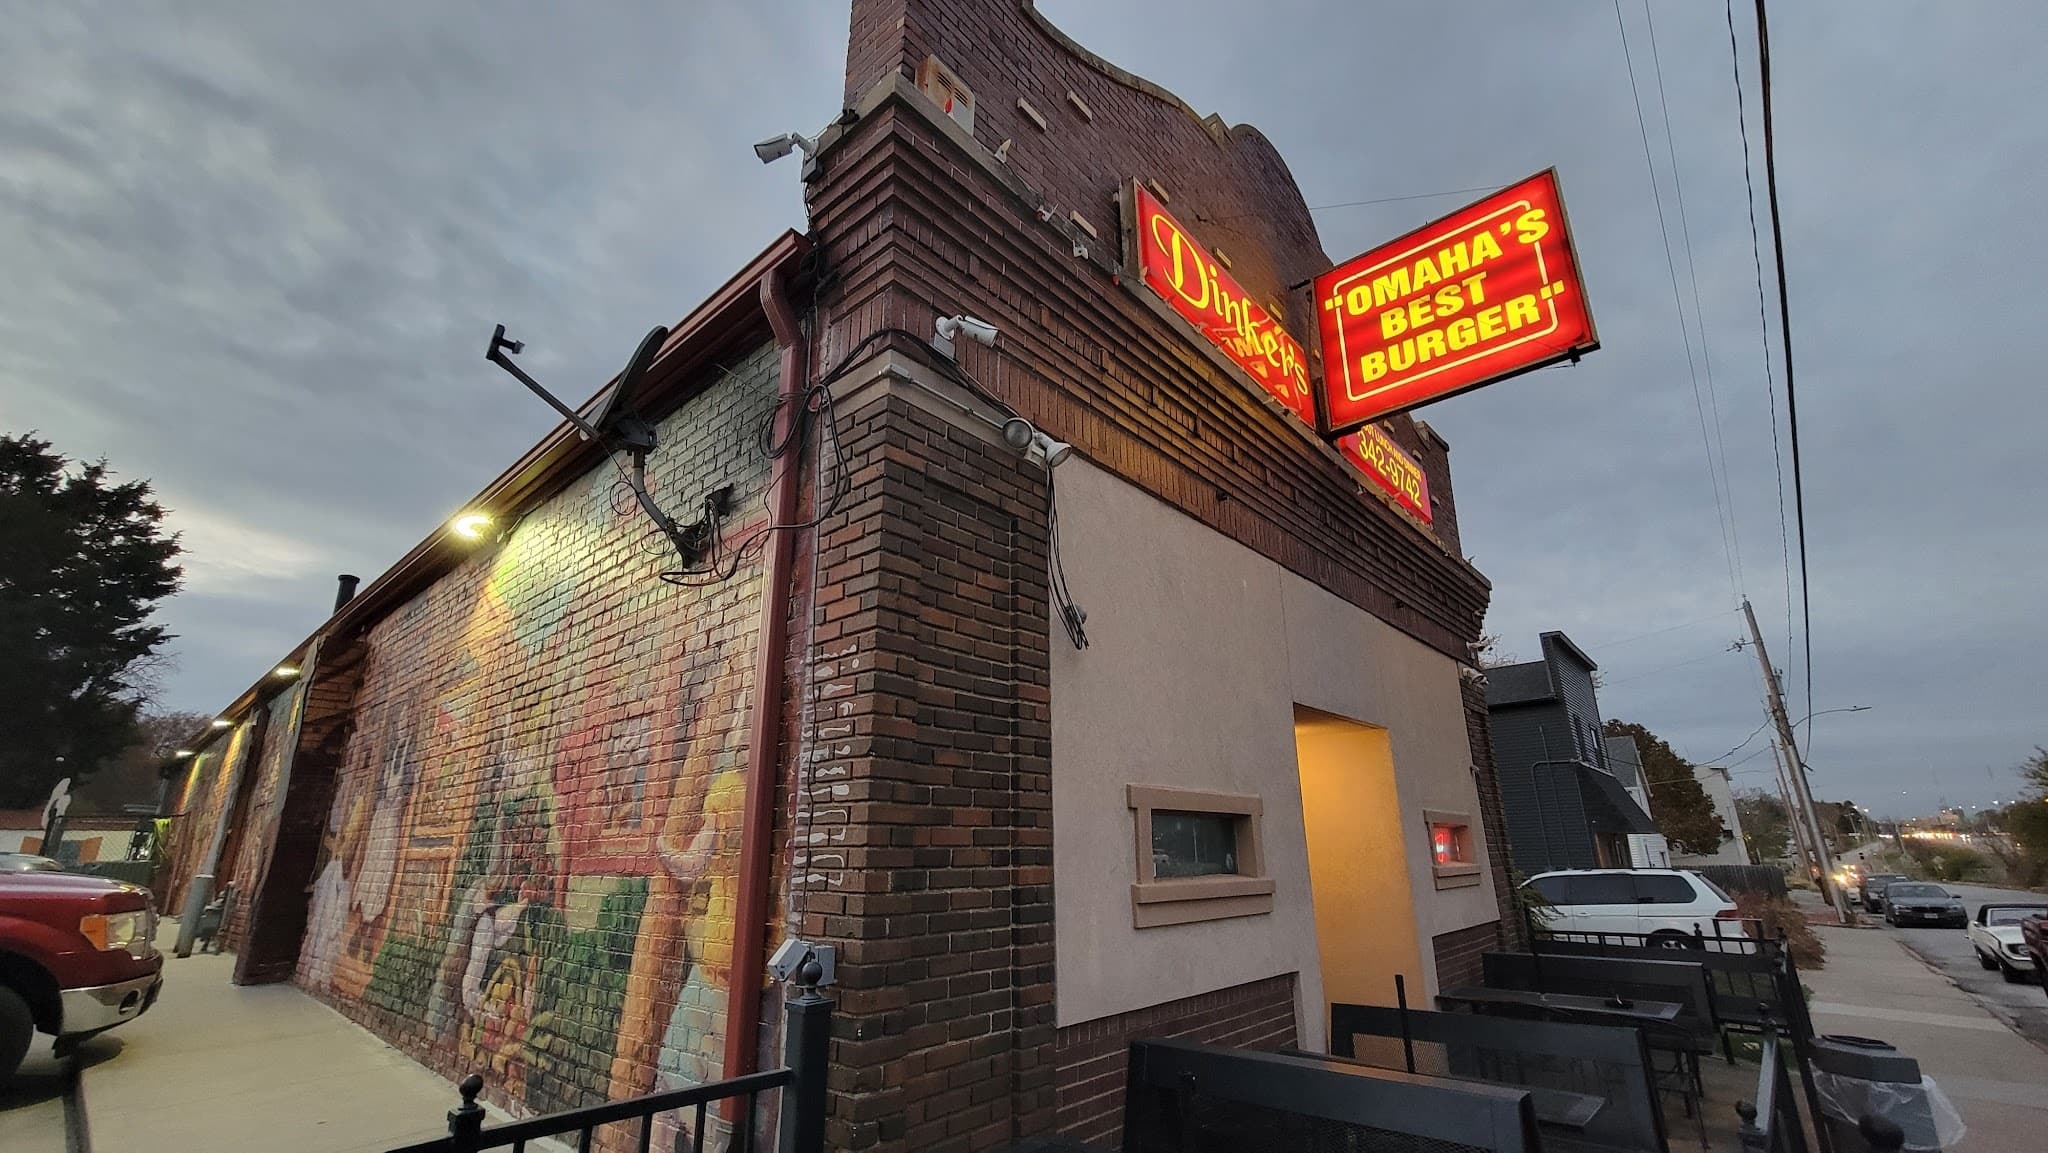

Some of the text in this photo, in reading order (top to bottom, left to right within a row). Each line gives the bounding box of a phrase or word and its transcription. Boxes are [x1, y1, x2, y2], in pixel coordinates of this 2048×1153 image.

[1152, 213, 1309, 395] Dinker's
[1380, 272, 1487, 340] BEST
[1357, 431, 1422, 507] 342-9742
